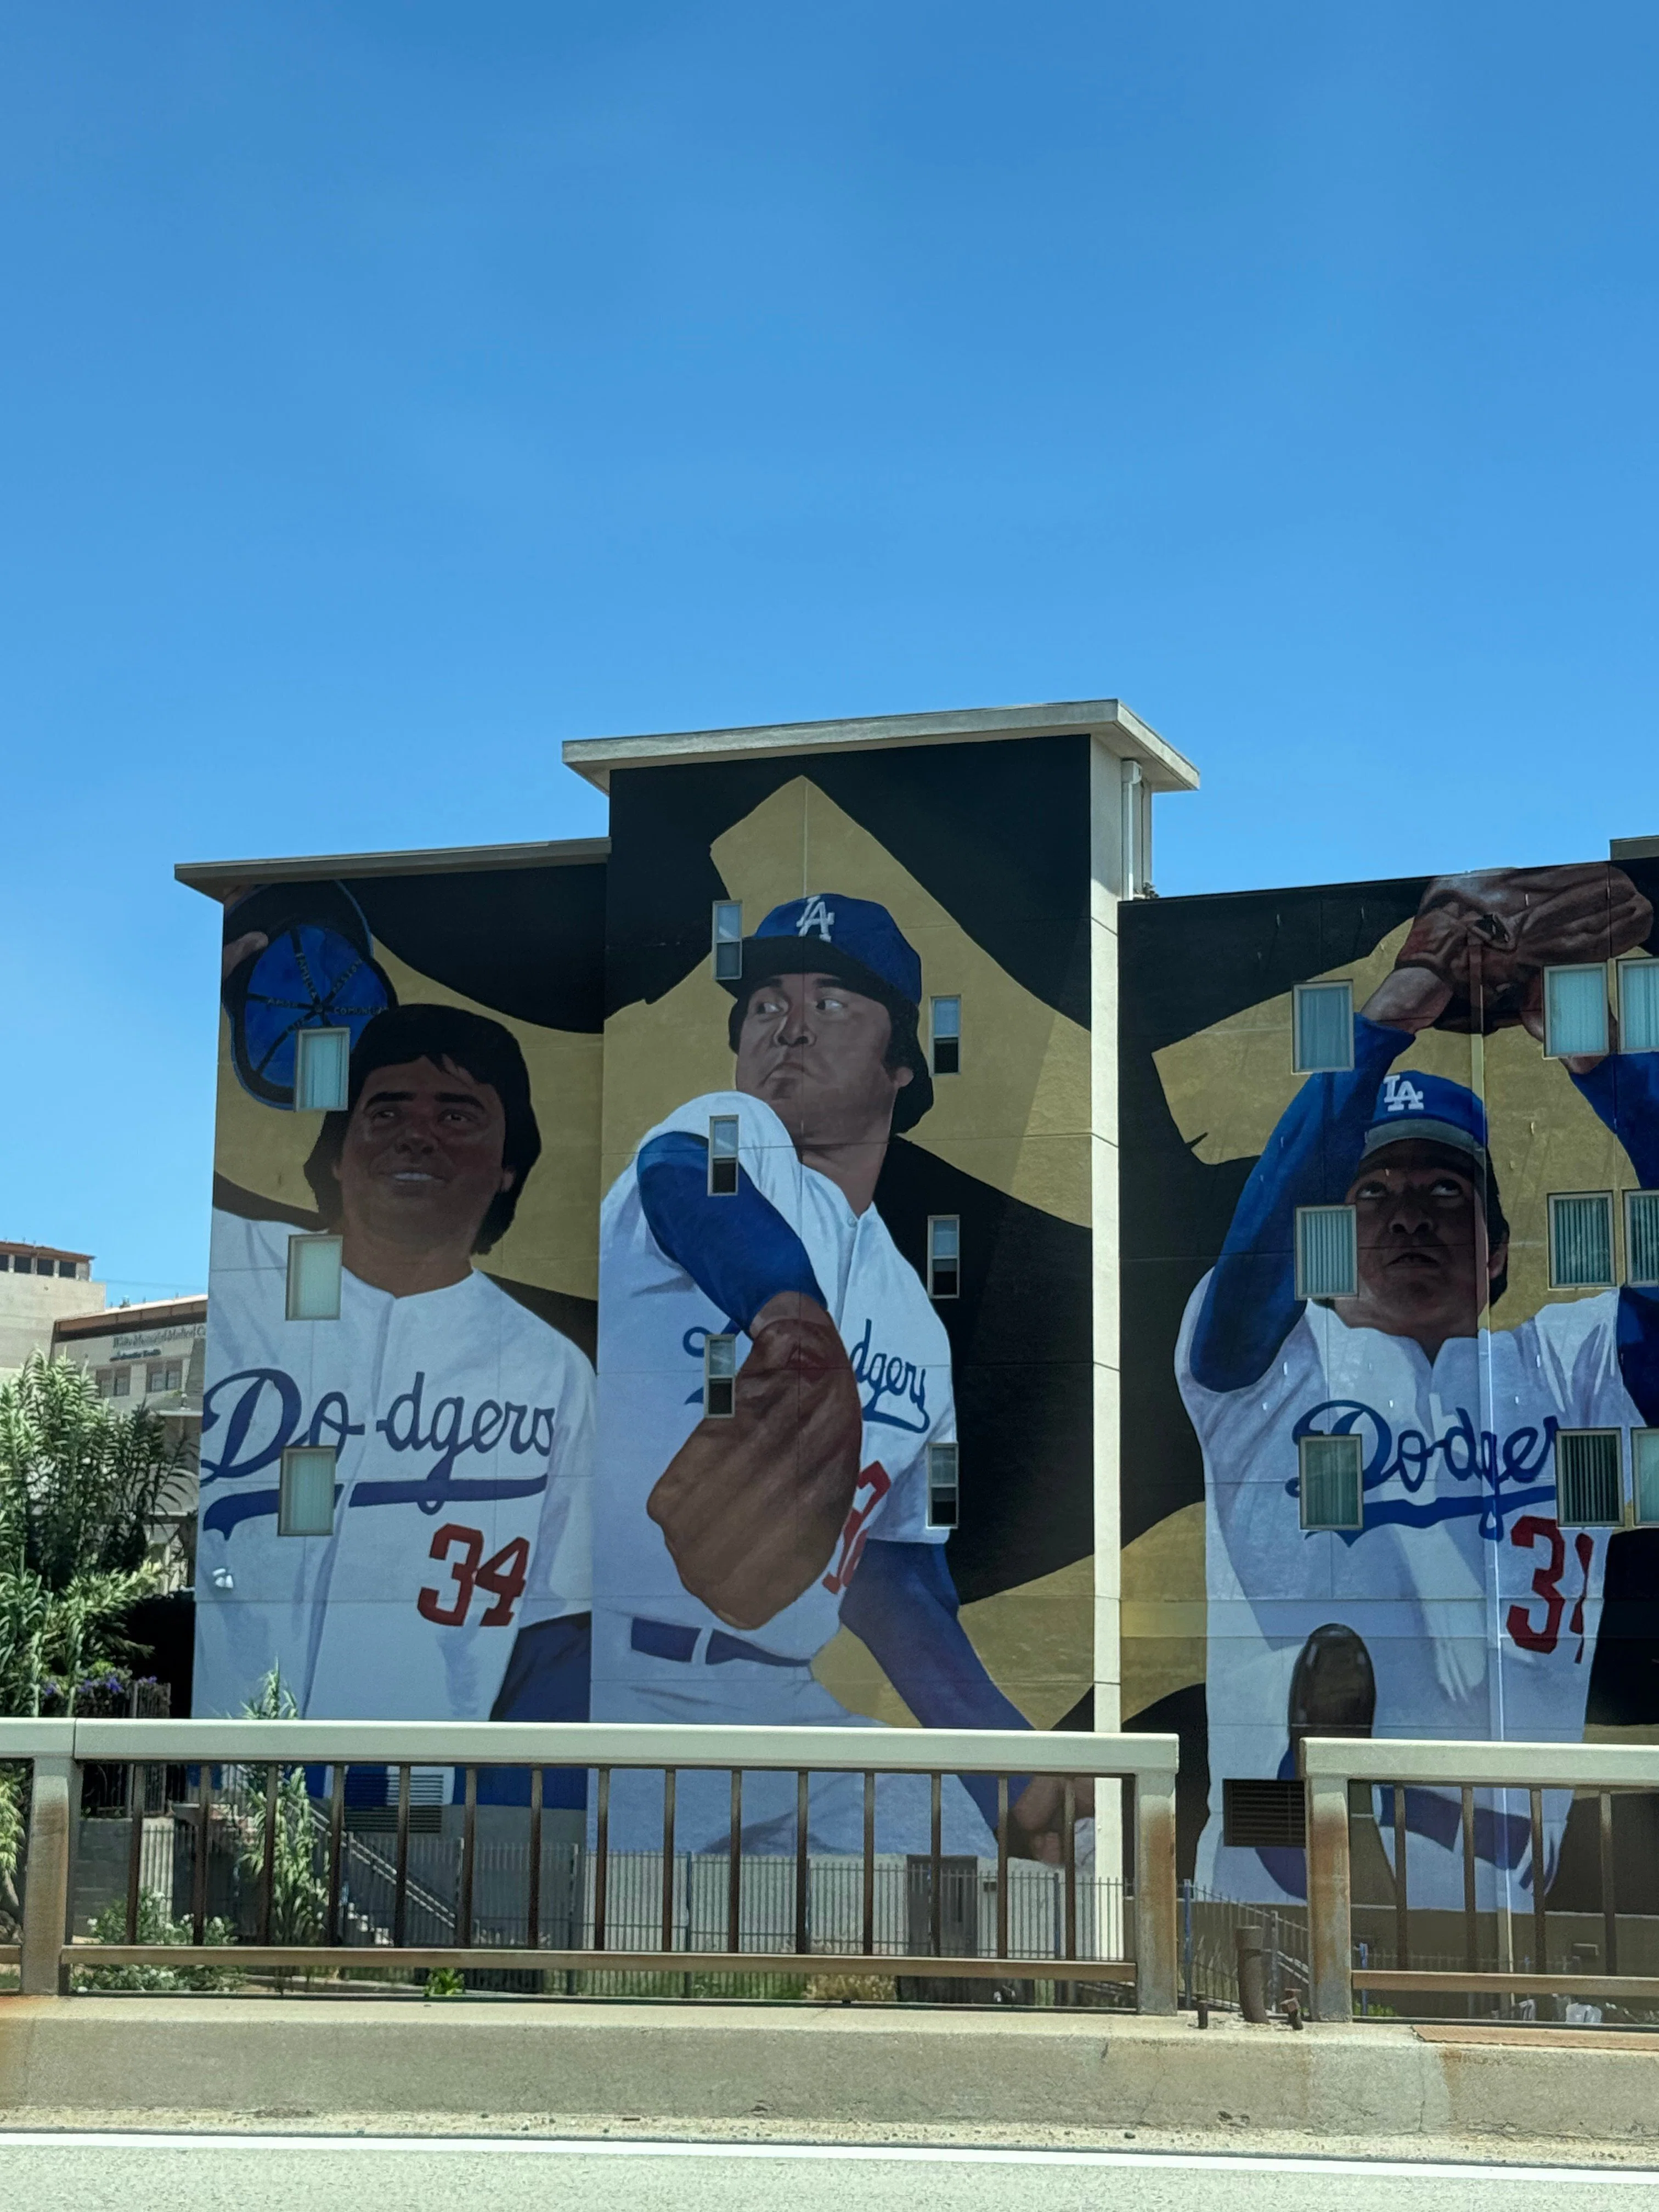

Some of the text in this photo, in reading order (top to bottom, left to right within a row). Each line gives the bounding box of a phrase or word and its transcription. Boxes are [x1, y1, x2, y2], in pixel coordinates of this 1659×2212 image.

[797, 895, 835, 942] LA
[1383, 1075, 1425, 1111] LA
[417, 1523, 531, 1627] 34
